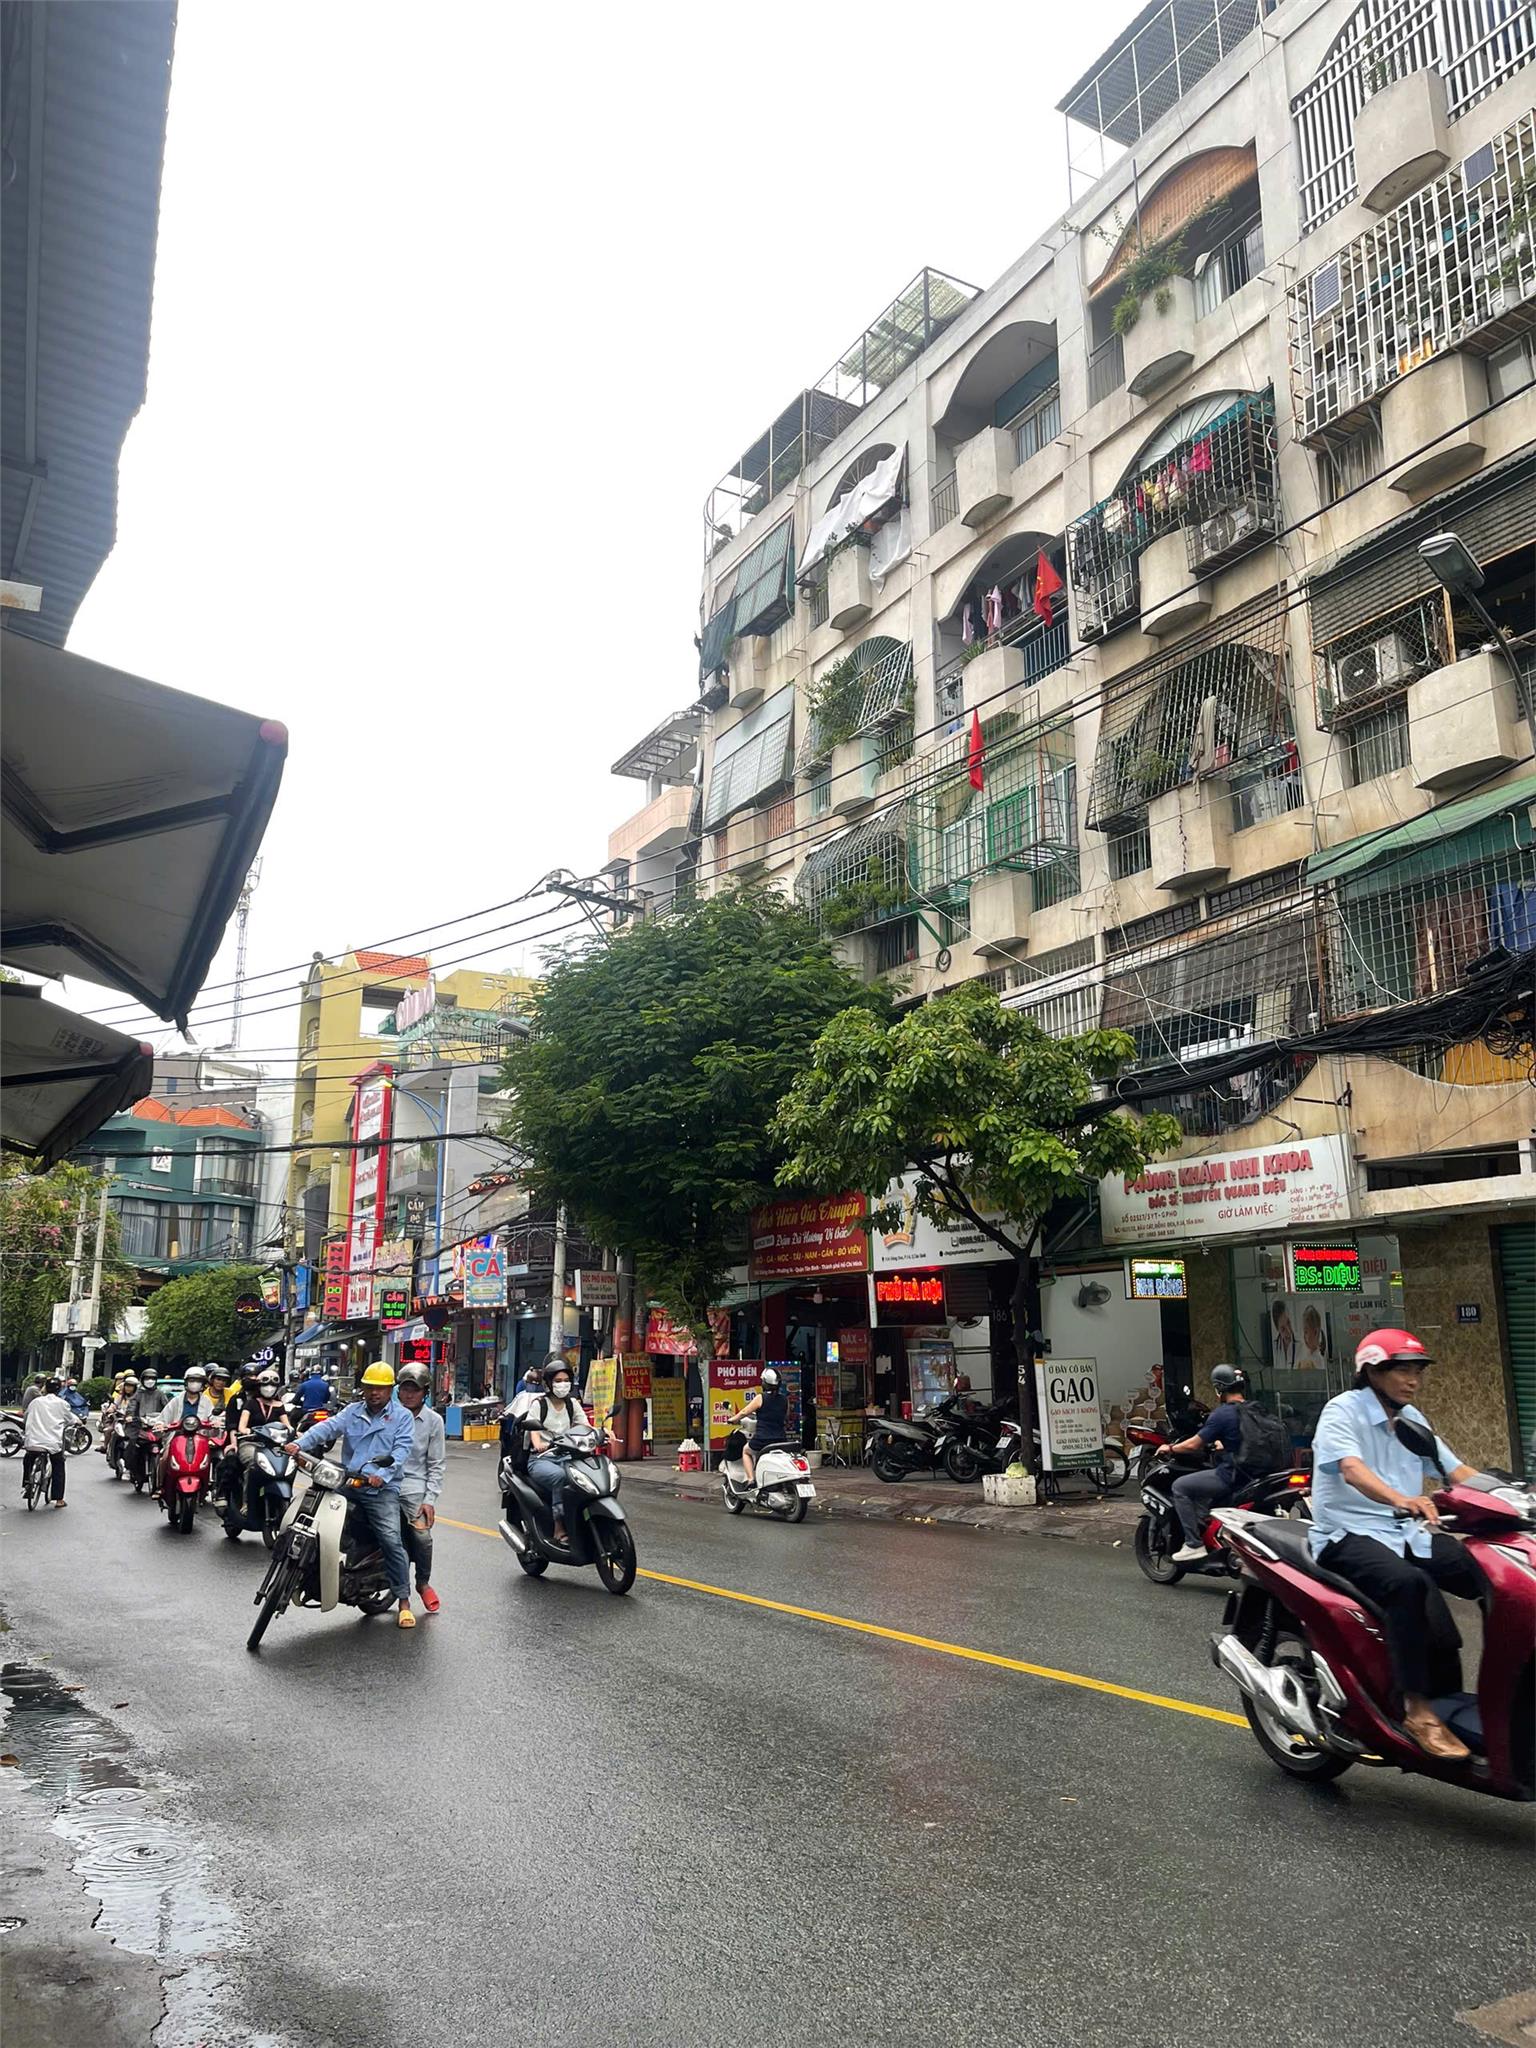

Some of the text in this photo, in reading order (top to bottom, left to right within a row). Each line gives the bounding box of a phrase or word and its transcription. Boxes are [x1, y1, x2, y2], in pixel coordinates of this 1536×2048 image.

[1178, 1160, 1227, 1187] KHÁM
[1230, 1157, 1260, 1180] NHI
[1263, 1149, 1313, 1175] KHOA
[1224, 1183, 1260, 1201] QUANG
[1262, 1177, 1287, 1196] DIỆU
[1218, 1202, 1274, 1219] GIỜ LÀM VIỆC
[470, 1252, 501, 1278] CÁ
[1296, 1265, 1322, 1286] BS:
[877, 1275, 901, 1302] PHỞ
[902, 1277, 921, 1302] HÀ
[1460, 1306, 1477, 1317] 180
[717, 1364, 736, 1377] PHỞ
[1050, 1376, 1095, 1404] GẠO
